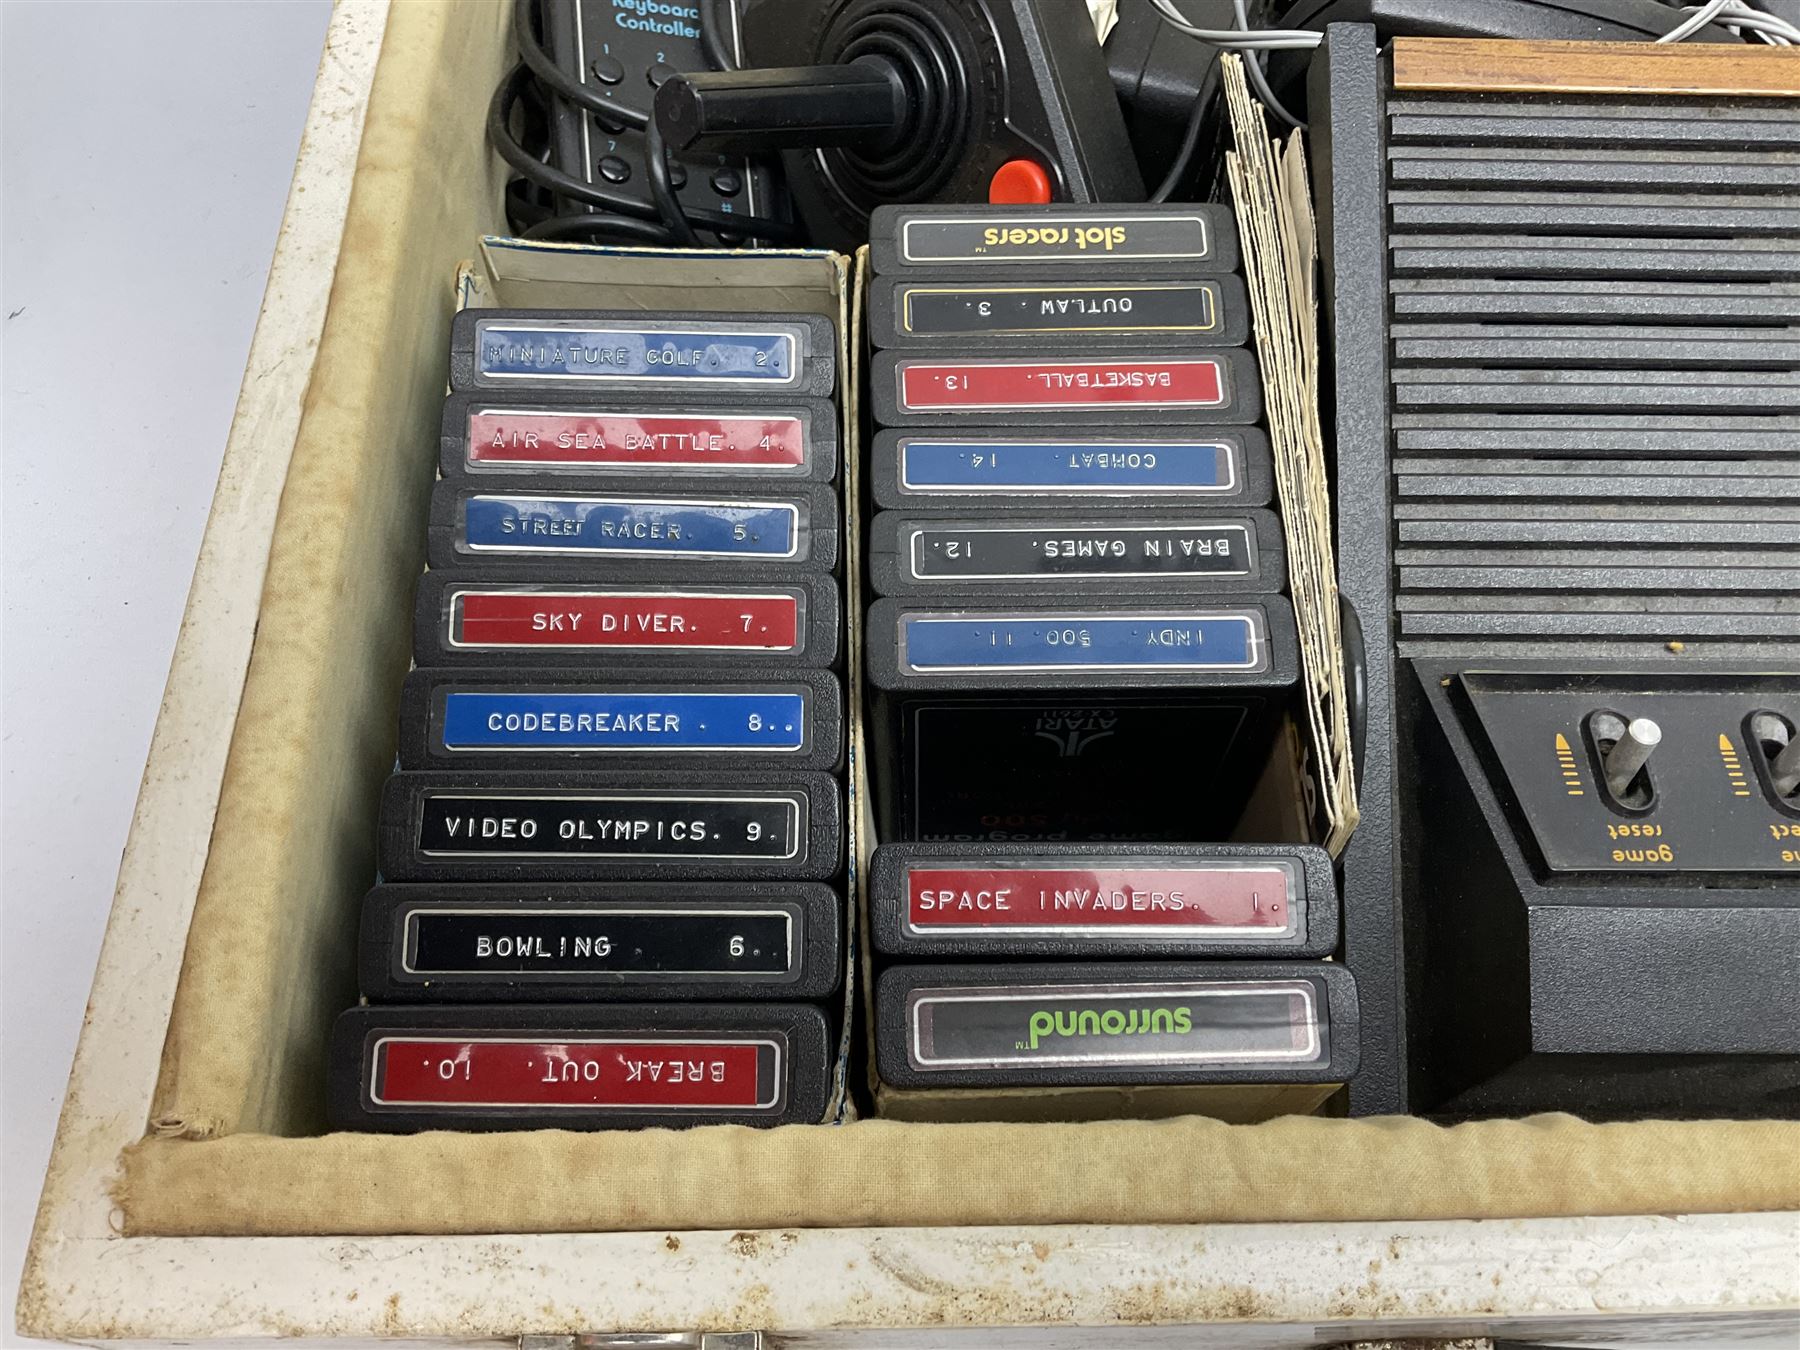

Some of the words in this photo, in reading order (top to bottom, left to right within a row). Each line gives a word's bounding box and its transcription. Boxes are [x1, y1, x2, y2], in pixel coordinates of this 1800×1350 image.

[615, 13, 701, 39] Controller
[603, 43, 610, 55] 1
[656, 52, 665, 63] 2
[608, 140, 617, 151] 7
[1075, 227, 1126, 250] slot
[966, 301, 992, 315] 3.
[490, 347, 629, 366] MINIATURE
[646, 350, 718, 367] GOLF.
[755, 351, 780, 367] 2.
[934, 374, 968, 390] 13.
[1026, 371, 1171, 388] BASKETBALL.
[492, 432, 539, 449] AIR
[558, 433, 606, 449] SEA
[625, 434, 736, 451] BATTLE.
[759, 435, 785, 451] 4.
[959, 453, 996, 468] 14.
[1054, 453, 1156, 468] COMBAT.
[502, 517, 585, 536] STREET
[601, 523, 693, 540] RACER.
[733, 525, 759, 542] 5.
[933, 541, 971, 557] 12.
[1032, 540, 1126, 556] GAMES.
[1144, 539, 1230, 556] BRAIN
[532, 613, 583, 632] SKY
[602, 613, 697, 632] DIVER.
[739, 614, 767, 633] 7.
[1034, 630, 1092, 646] 500.
[1131, 629, 1203, 646] INDY.
[1036, 717, 1119, 731] ATARI
[445, 817, 538, 839] VIDEO
[559, 819, 722, 842] OLYMPICS.
[745, 821, 778, 842] 9.
[1607, 824, 1662, 840] reset
[1612, 844, 1674, 863] game
[919, 889, 1011, 911] SPACE
[1039, 889, 1200, 912] INVADERS.
[1253, 891, 1280, 912] 1.
[527, 1060, 600, 1083] OUT.
[625, 1060, 725, 1083] BREAK
